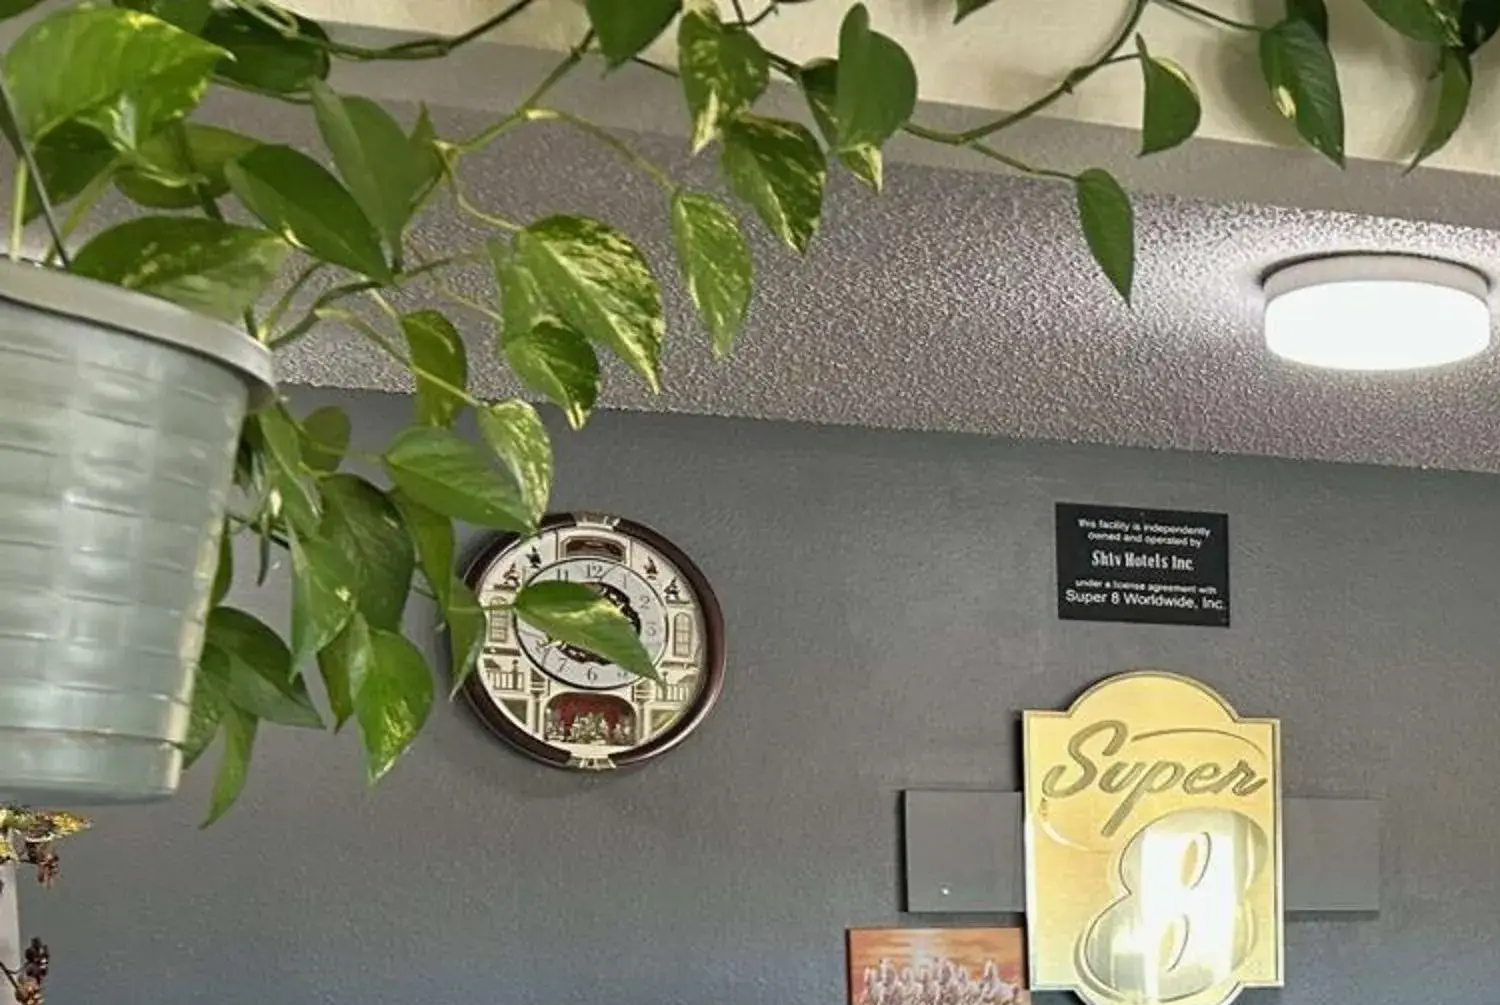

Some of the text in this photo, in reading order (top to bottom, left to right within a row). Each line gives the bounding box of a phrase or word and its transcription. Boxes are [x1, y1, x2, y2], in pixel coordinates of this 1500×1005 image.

[1099, 519, 1130, 533] facility
[1132, 523, 1142, 531] is
[1143, 524, 1211, 538] independently
[1123, 533, 1143, 543] and
[1144, 535, 1188, 547] operated
[1189, 538, 1202, 549] by
[1091, 549, 1122, 568] Shiv
[1124, 551, 1169, 570] Hotels
[1065, 588, 1108, 605] Super
[1111, 591, 1121, 605] 8
[1075, 579, 1103, 588] under
[1147, 583, 1197, 594] agreement
[1198, 586, 1217, 595] with
[1041, 719, 1268, 838] Super
[1075, 807, 1268, 1005] 8
